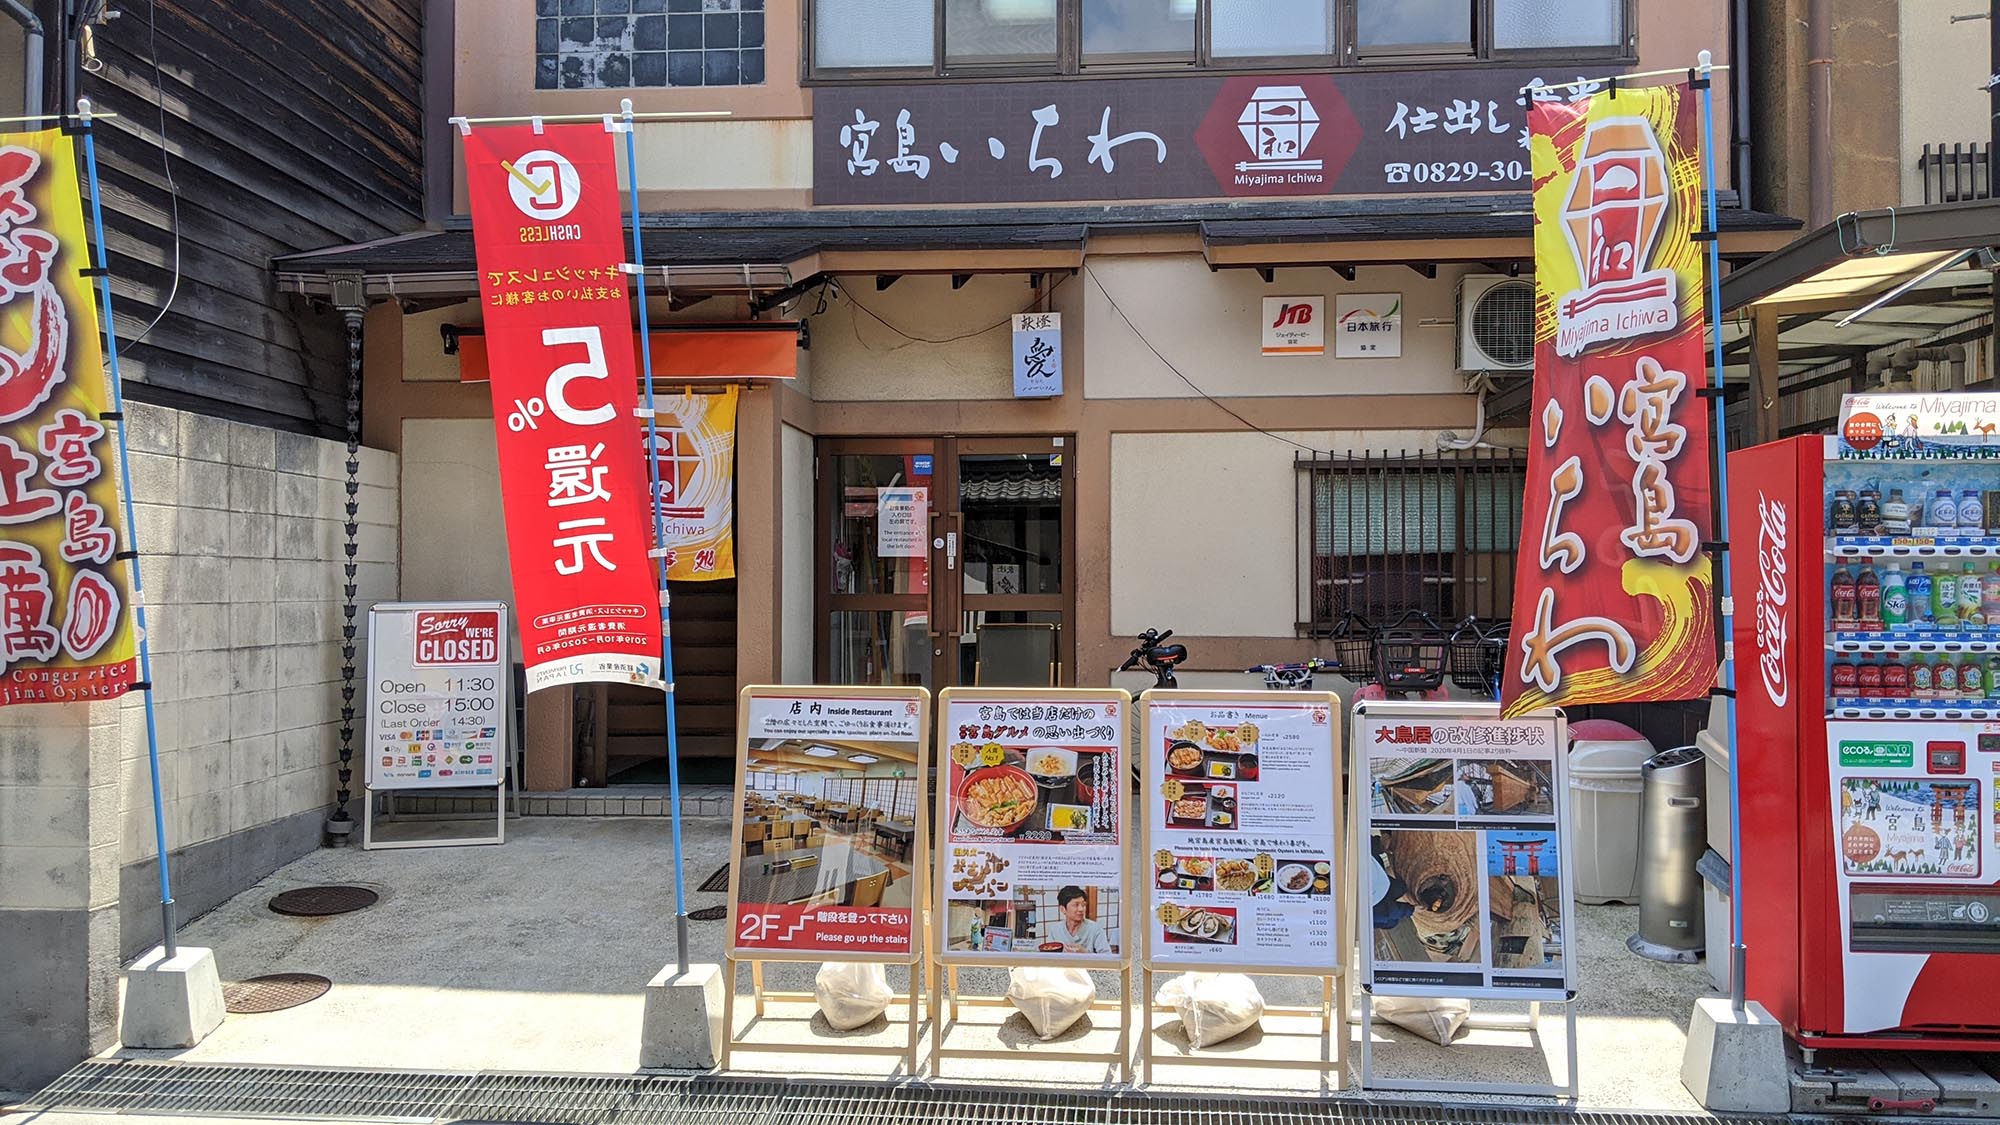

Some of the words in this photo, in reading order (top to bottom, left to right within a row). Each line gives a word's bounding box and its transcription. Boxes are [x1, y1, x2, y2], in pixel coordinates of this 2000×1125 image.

[1385, 99, 1510, 139] 仕出し
[840, 104, 1167, 179] 宮島いちわ
[1234, 174, 1284, 187] Miyajima
[1287, 173, 1323, 184] Ichiwa
[1414, 160, 1532, 183] 0829-30-
[1272, 304, 1313, 328] JTB
[1347, 321, 1393, 333] 日本旅行
[1561, 317, 1609, 350] Miyajima
[1616, 308, 1669, 332] Ichiwa
[1024, 336, 1056, 378] 愛
[1876, 402, 1907, 410] Welcome
[1920, 397, 1997, 417] Miyajima
[1759, 489, 1787, 708] Coca-Cola
[420, 616, 469, 635] Sorry
[465, 628, 494, 638] WE'RE
[420, 640, 494, 661] CLOSED
[12, 669, 79, 685] Conger
[89, 663, 128, 680] rice
[3, 685, 46, 704] jima
[54, 680, 129, 698] Oysters
[381, 680, 426, 695] Open
[444, 678, 494, 692] 11:30
[381, 700, 426, 714] Close
[444, 698, 494, 711] 15:00
[789, 700, 822, 715] 店内
[852, 708, 893, 716] Restaurant
[979, 705, 1096, 721] 宮島では当店だけの
[1210, 711, 1240, 720] お品書き
[1245, 712, 1269, 720] Menue
[381, 719, 407, 729] (Last
[410, 718, 440, 727] Order
[452, 716, 485, 726] 14:30)
[1376, 726, 1545, 745] 大鳥居の改修進捗状
[1885, 804, 1915, 812] Welcome
[1885, 813, 1926, 832] 宮島
[817, 911, 908, 924] 階段を登って下さい
[740, 914, 781, 941] 2F
[816, 933, 843, 942] Please
[844, 935, 855, 943] go
[857, 935, 868, 943] up
[869, 934, 884, 943] the
[885, 934, 908, 944] stairs
